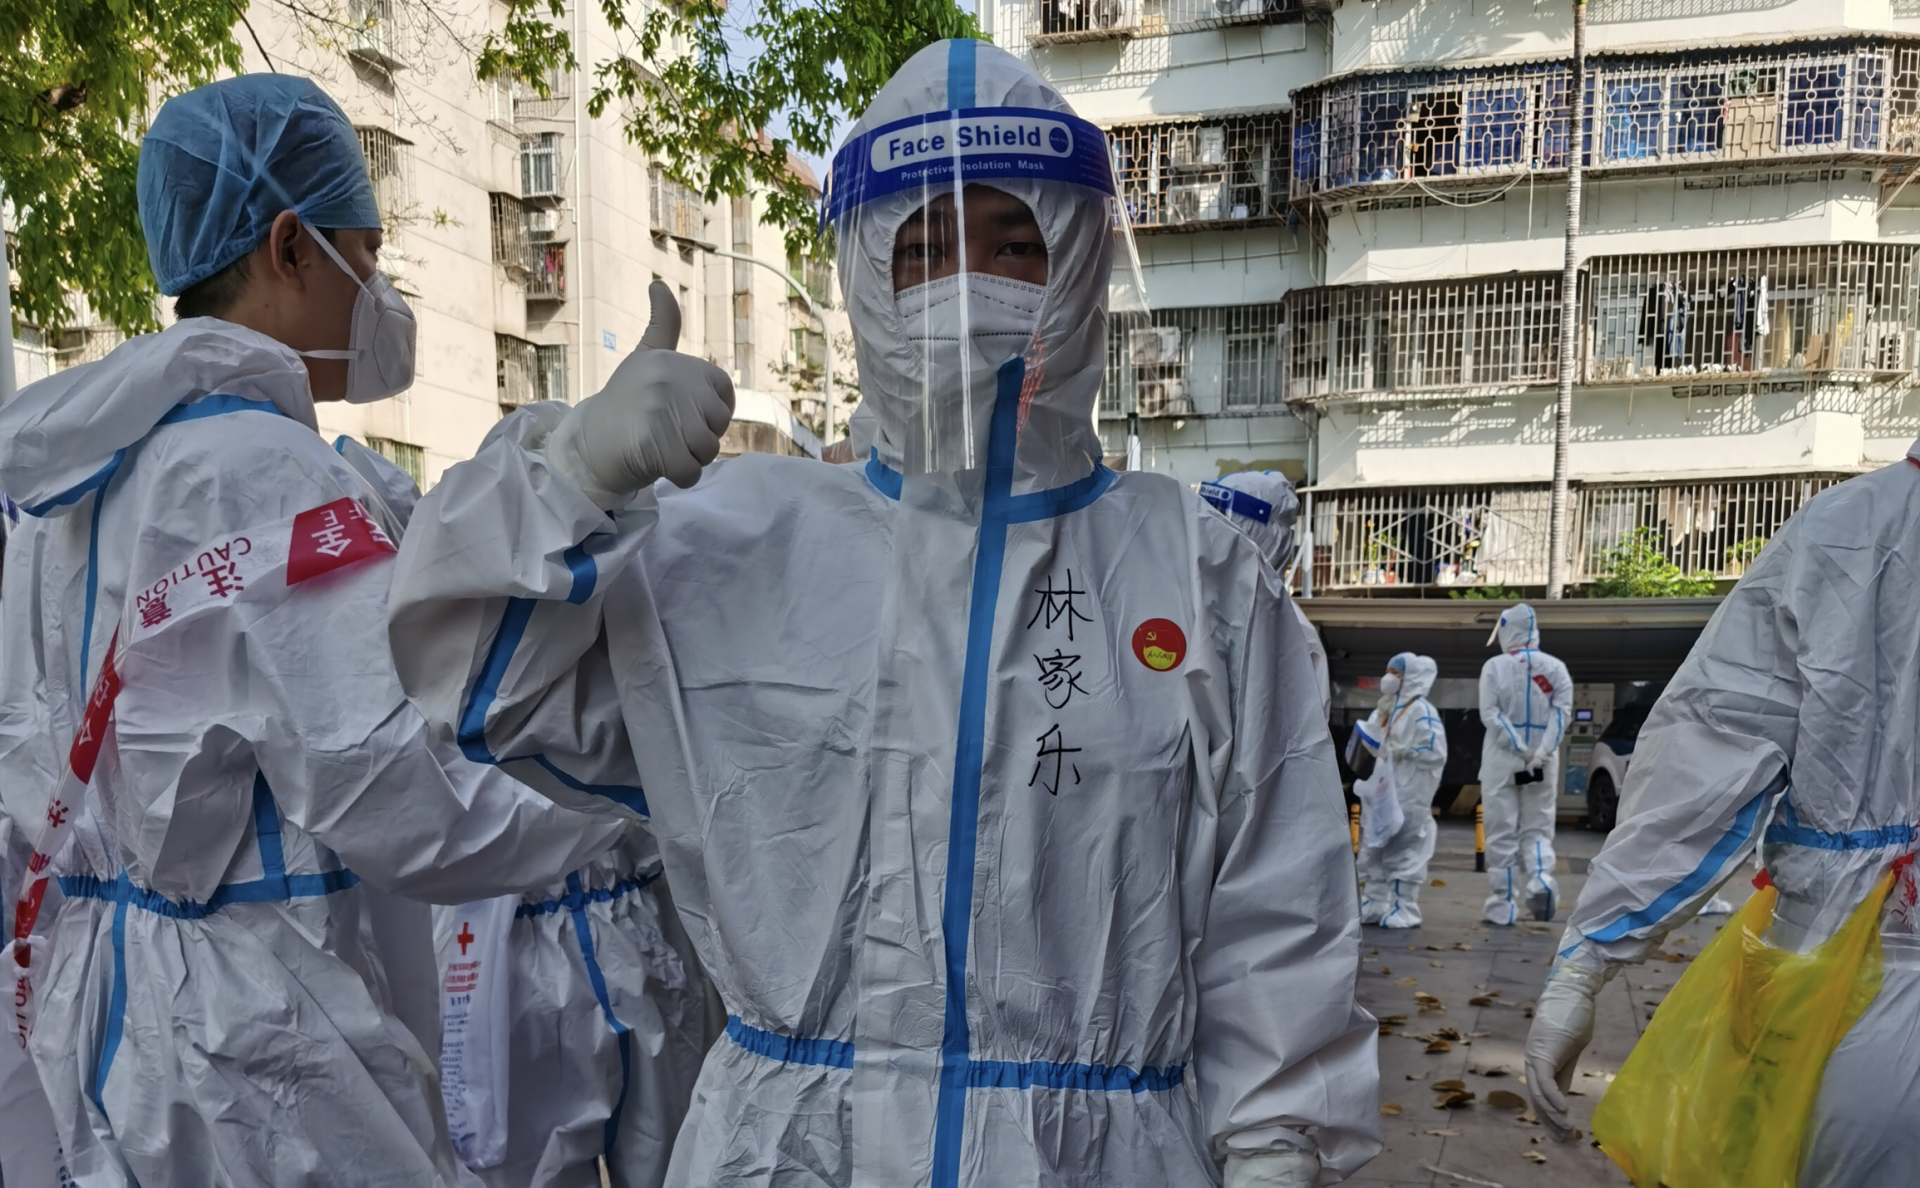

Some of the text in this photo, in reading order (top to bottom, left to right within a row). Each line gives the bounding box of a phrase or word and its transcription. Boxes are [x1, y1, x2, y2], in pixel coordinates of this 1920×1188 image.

[888, 125, 1042, 161] Face Shield
[901, 160, 1045, 181] Protective Isolation Mask
[136, 537, 252, 609] CAUTION
[140, 561, 245, 629] 注意
[1027, 568, 1095, 796] 林家乐
